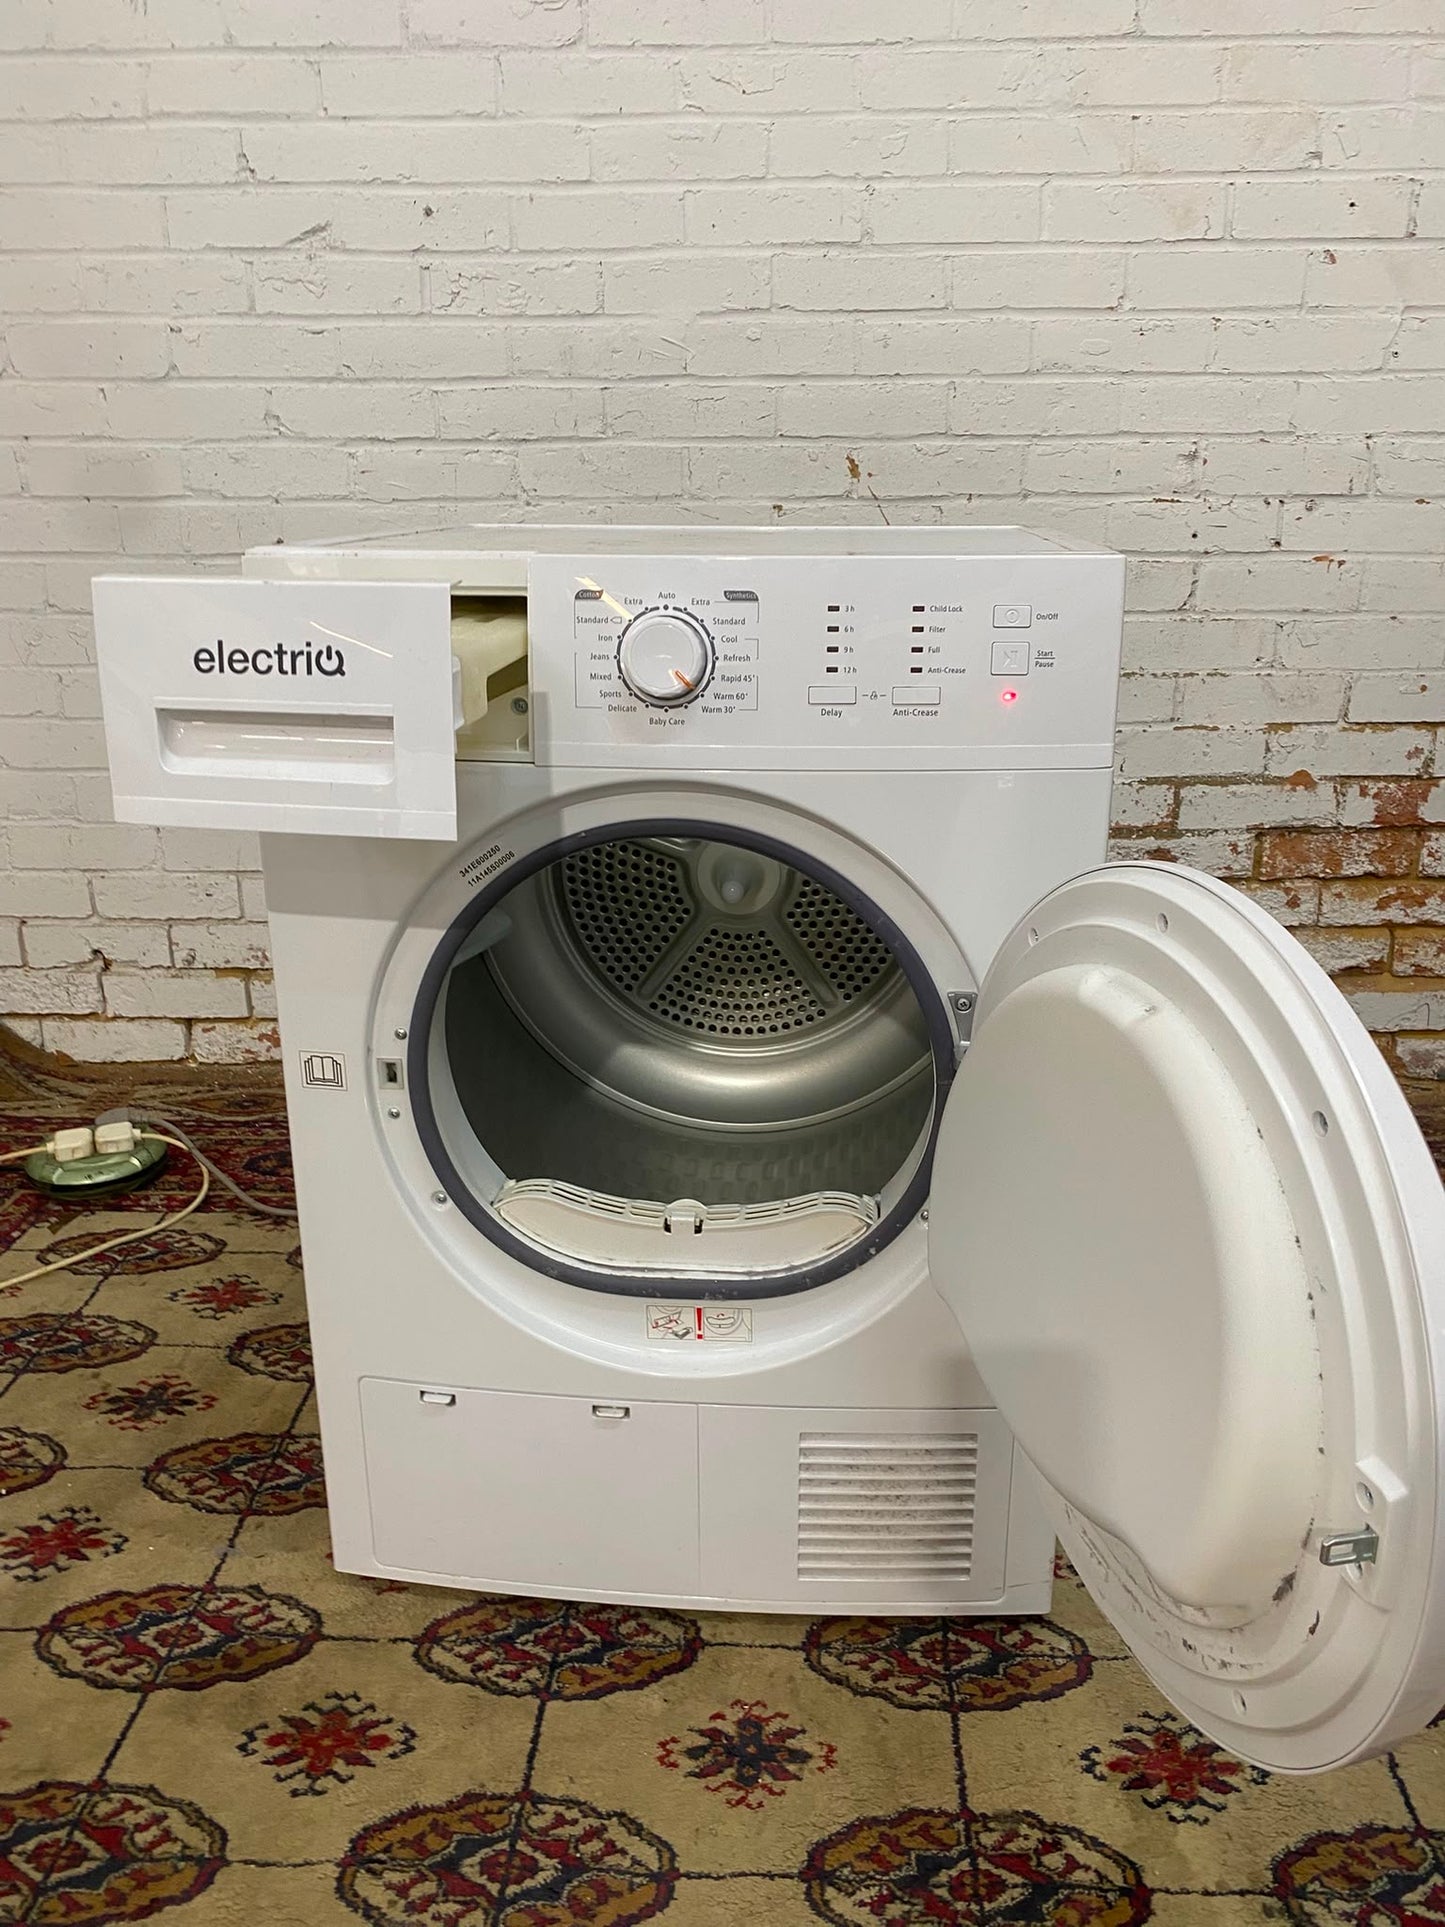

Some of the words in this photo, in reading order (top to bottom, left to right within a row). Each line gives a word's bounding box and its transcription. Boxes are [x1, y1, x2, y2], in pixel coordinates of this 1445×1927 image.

[726, 591, 756, 600] Synthetics
[691, 598, 711, 606] Extra
[712, 617, 746, 625] Standard
[721, 635, 738, 643] Cool
[193, 639, 346, 677] electriQ
[590, 652, 610, 660] Jeans
[723, 654, 751, 662] Refresh
[720, 674, 742, 684] Rapid
[599, 690, 622, 699] Sports
[608, 704, 637, 712] Delicate
[892, 708, 939, 717] Anti-Crease
[820, 708, 843, 718] Delay
[649, 717, 667, 727] Baby
[668, 717, 685, 726] Care
